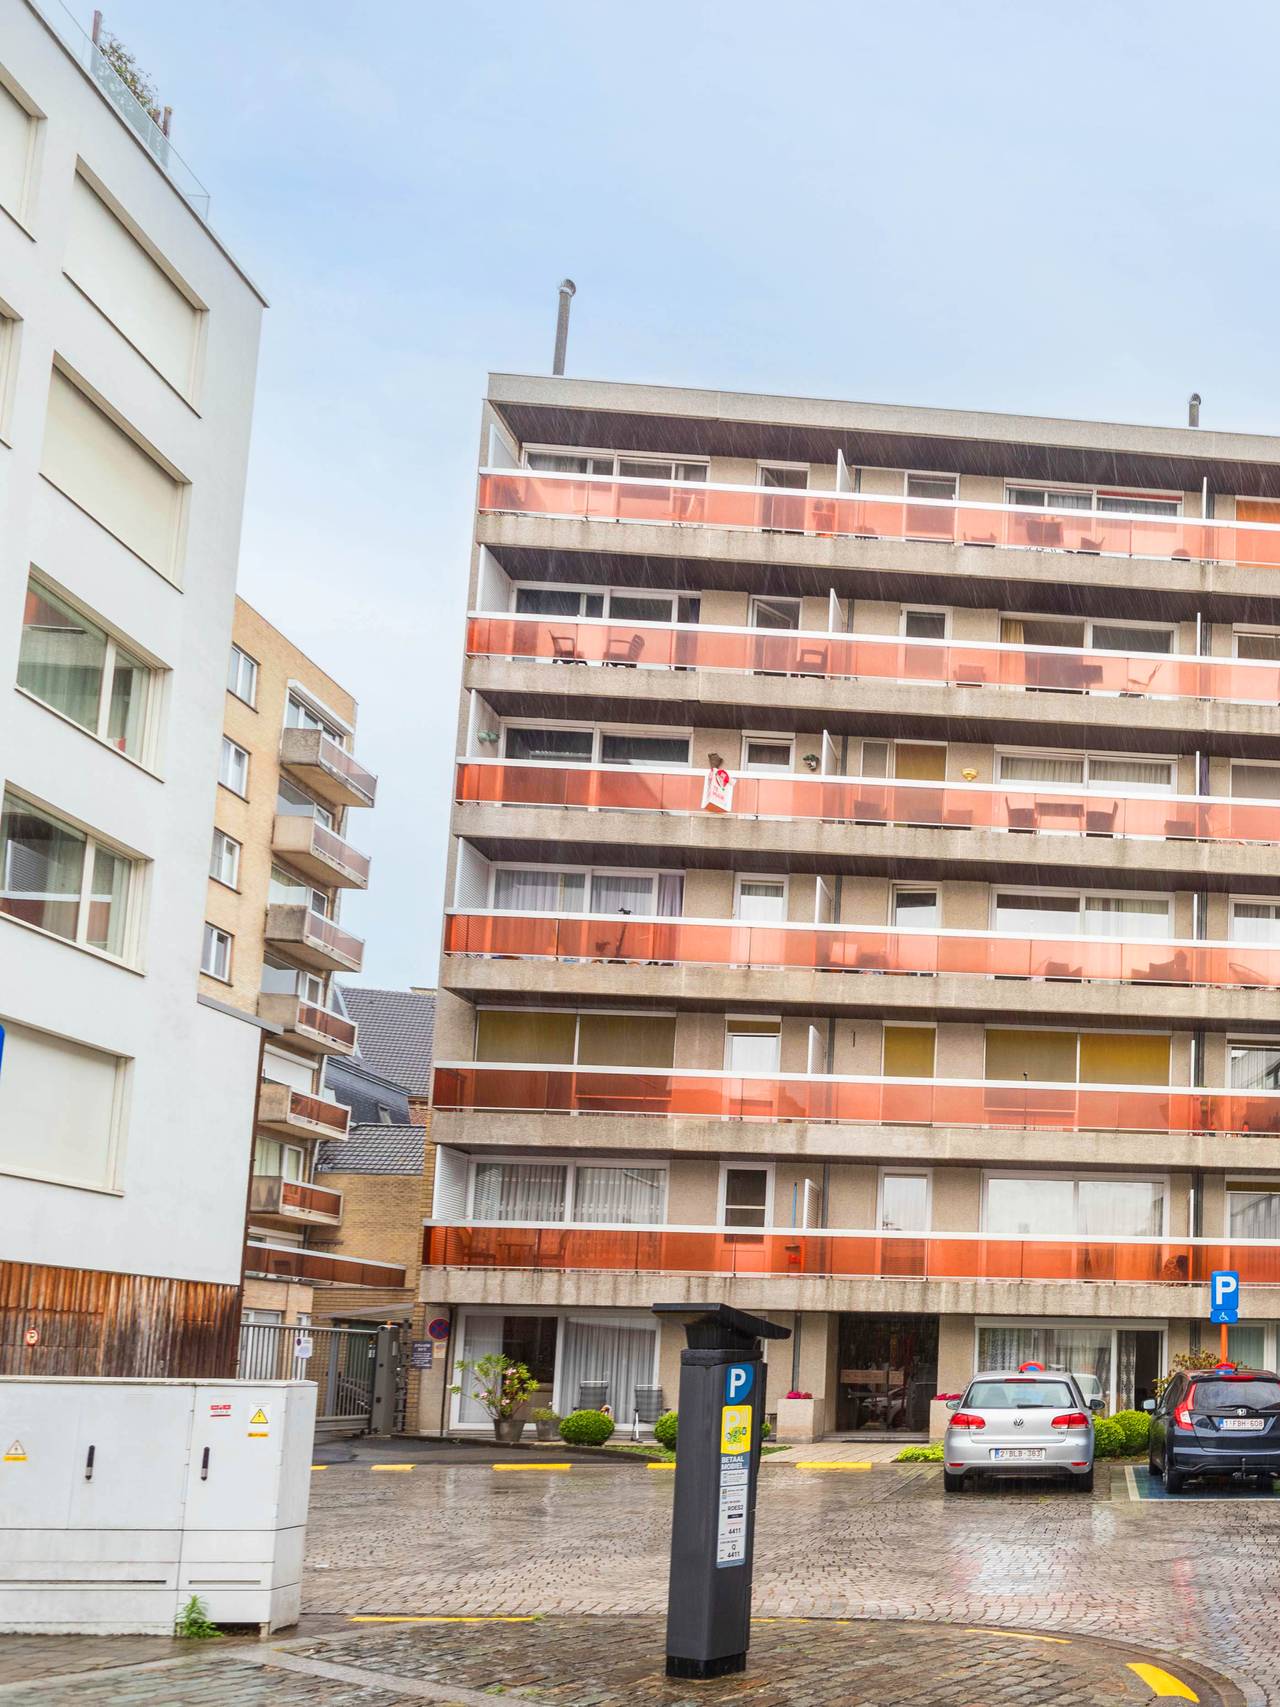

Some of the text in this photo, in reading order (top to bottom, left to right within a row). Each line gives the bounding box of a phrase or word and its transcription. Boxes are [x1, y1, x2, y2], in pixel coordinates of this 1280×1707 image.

[1215, 1276, 1237, 1305] P
[729, 1368, 746, 1398] P
[721, 1456, 744, 1464] BETAAL
